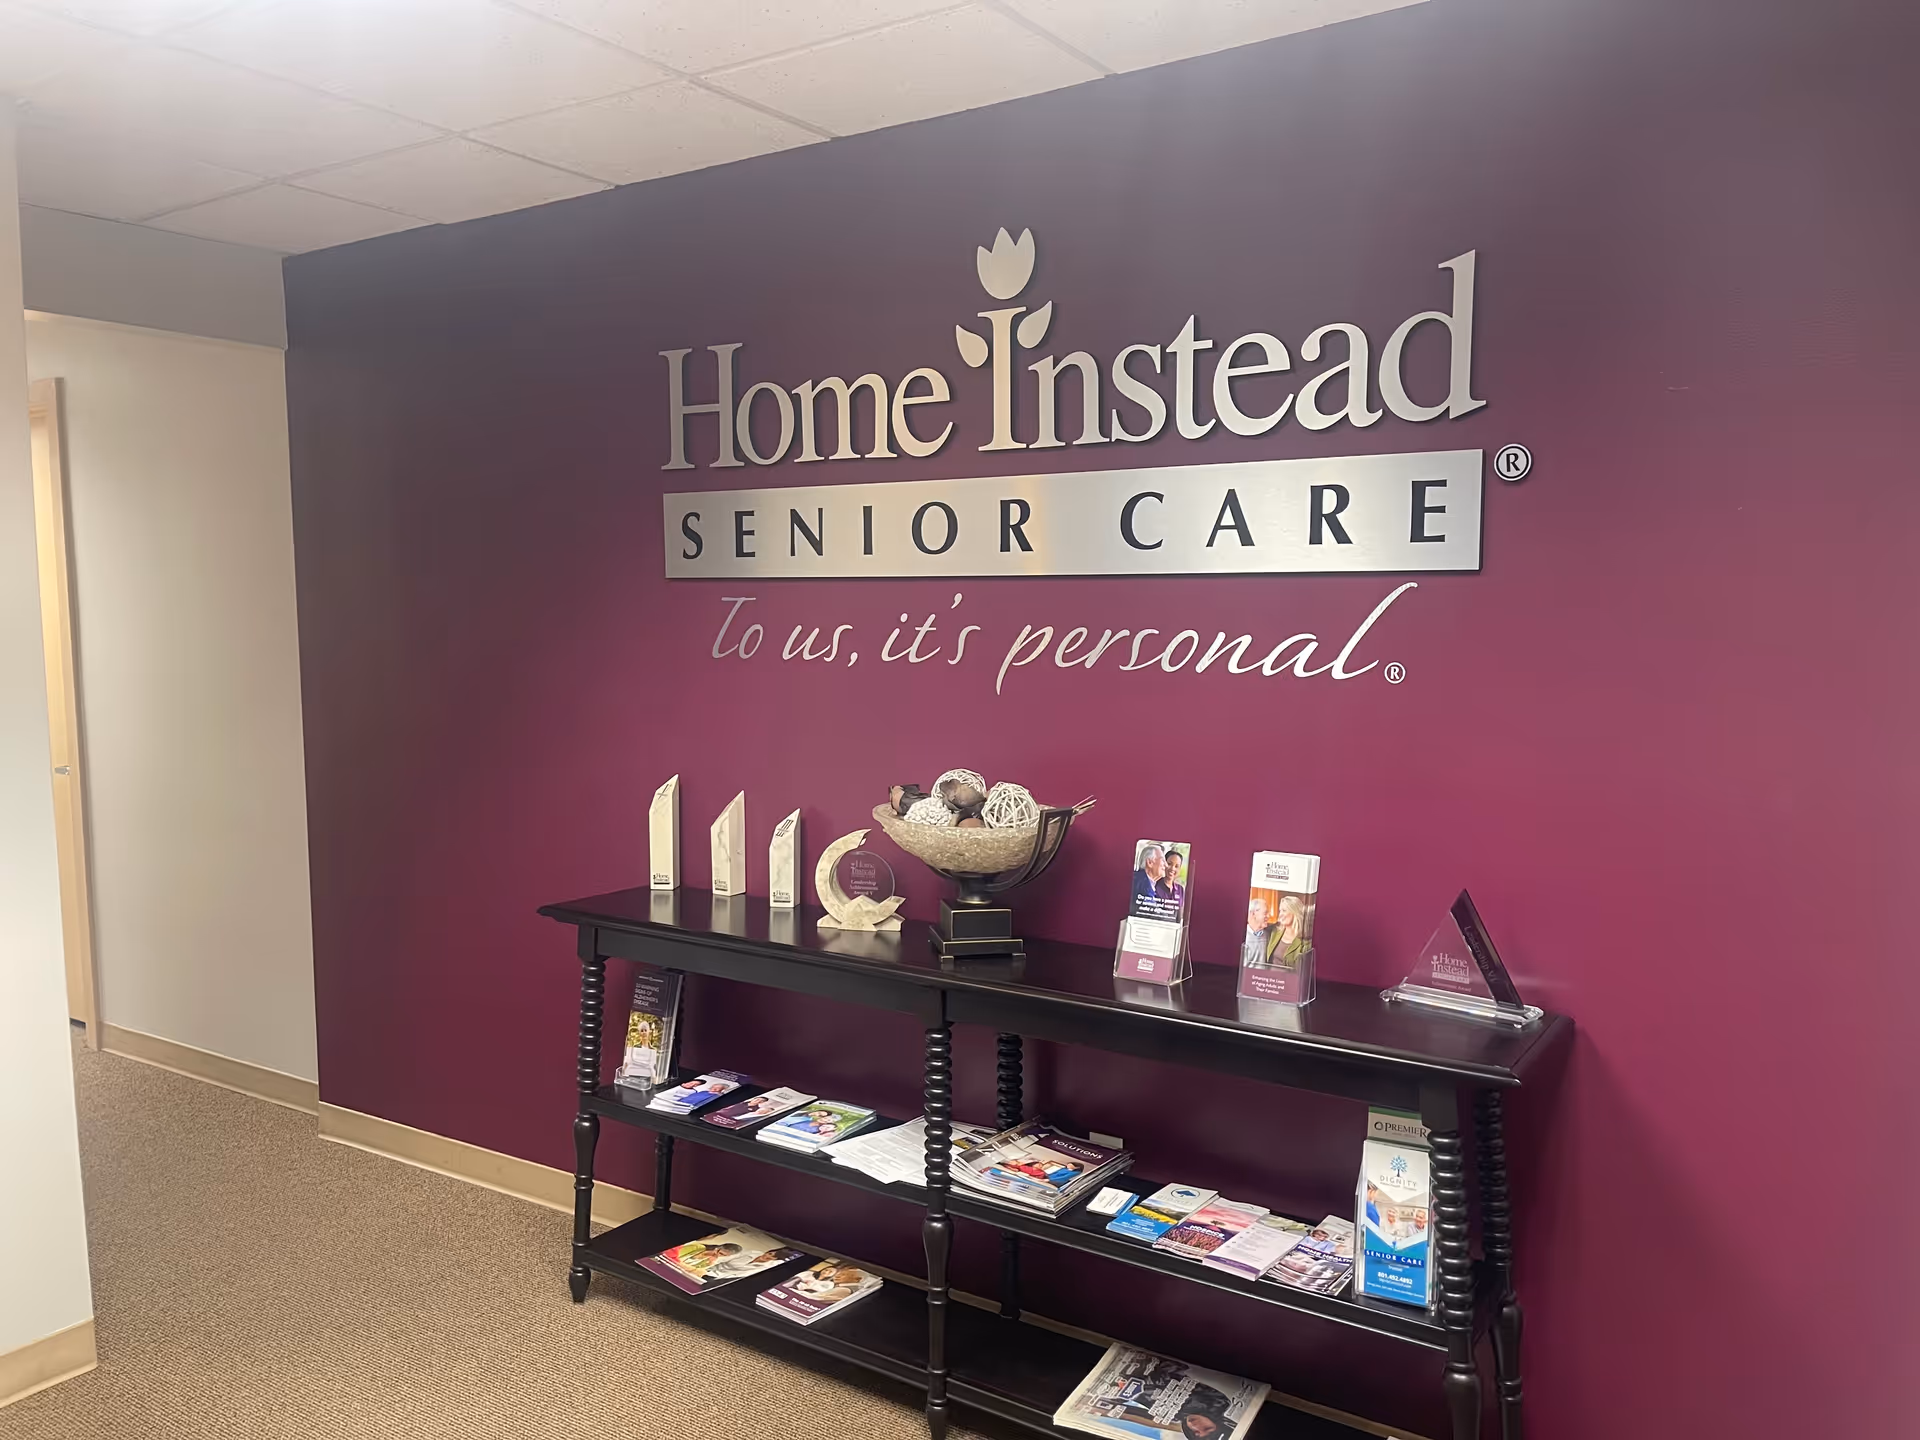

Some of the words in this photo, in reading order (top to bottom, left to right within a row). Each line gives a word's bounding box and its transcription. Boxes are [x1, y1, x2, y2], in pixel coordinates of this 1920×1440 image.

[658, 342, 955, 471] Home
[975, 249, 1487, 453] Instead
[680, 498, 1034, 560] SENIOR
[1120, 478, 1448, 551] CARE
[711, 596, 764, 660] To
[781, 624, 859, 668] us,
[880, 592, 981, 666] it's
[1439, 952, 1468, 968] Home
[1431, 960, 1470, 977] Instead
[1384, 1122, 1428, 1138] PREMIER
[1051, 1139, 1104, 1159] SOLUTIONS
[1379, 1174, 1418, 1188] DIGNITY
[1189, 1224, 1226, 1238] HOSPICE
[1297, 1245, 1322, 1257] HOME
[1366, 1250, 1397, 1261] SENIOR
[1400, 1256, 1423, 1266] CARE
